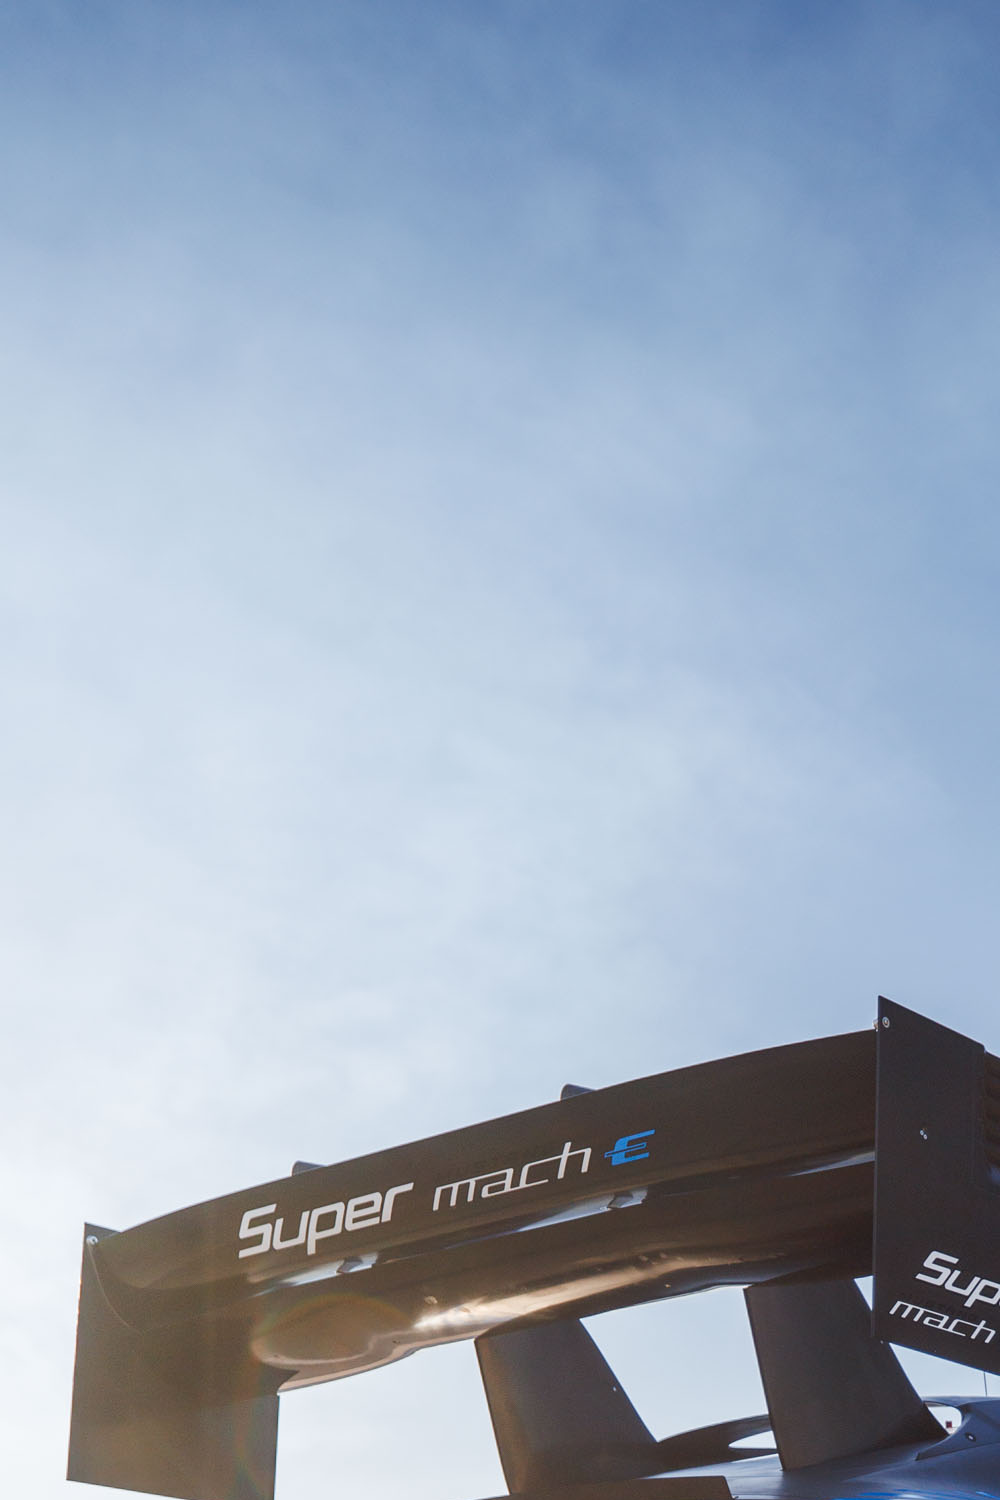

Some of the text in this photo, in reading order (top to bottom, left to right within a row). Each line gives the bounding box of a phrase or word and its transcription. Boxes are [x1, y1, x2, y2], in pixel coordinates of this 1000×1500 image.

[238, 1182, 414, 1259] Super
[432, 1141, 592, 1211] mach
[888, 1300, 996, 1344] mach
